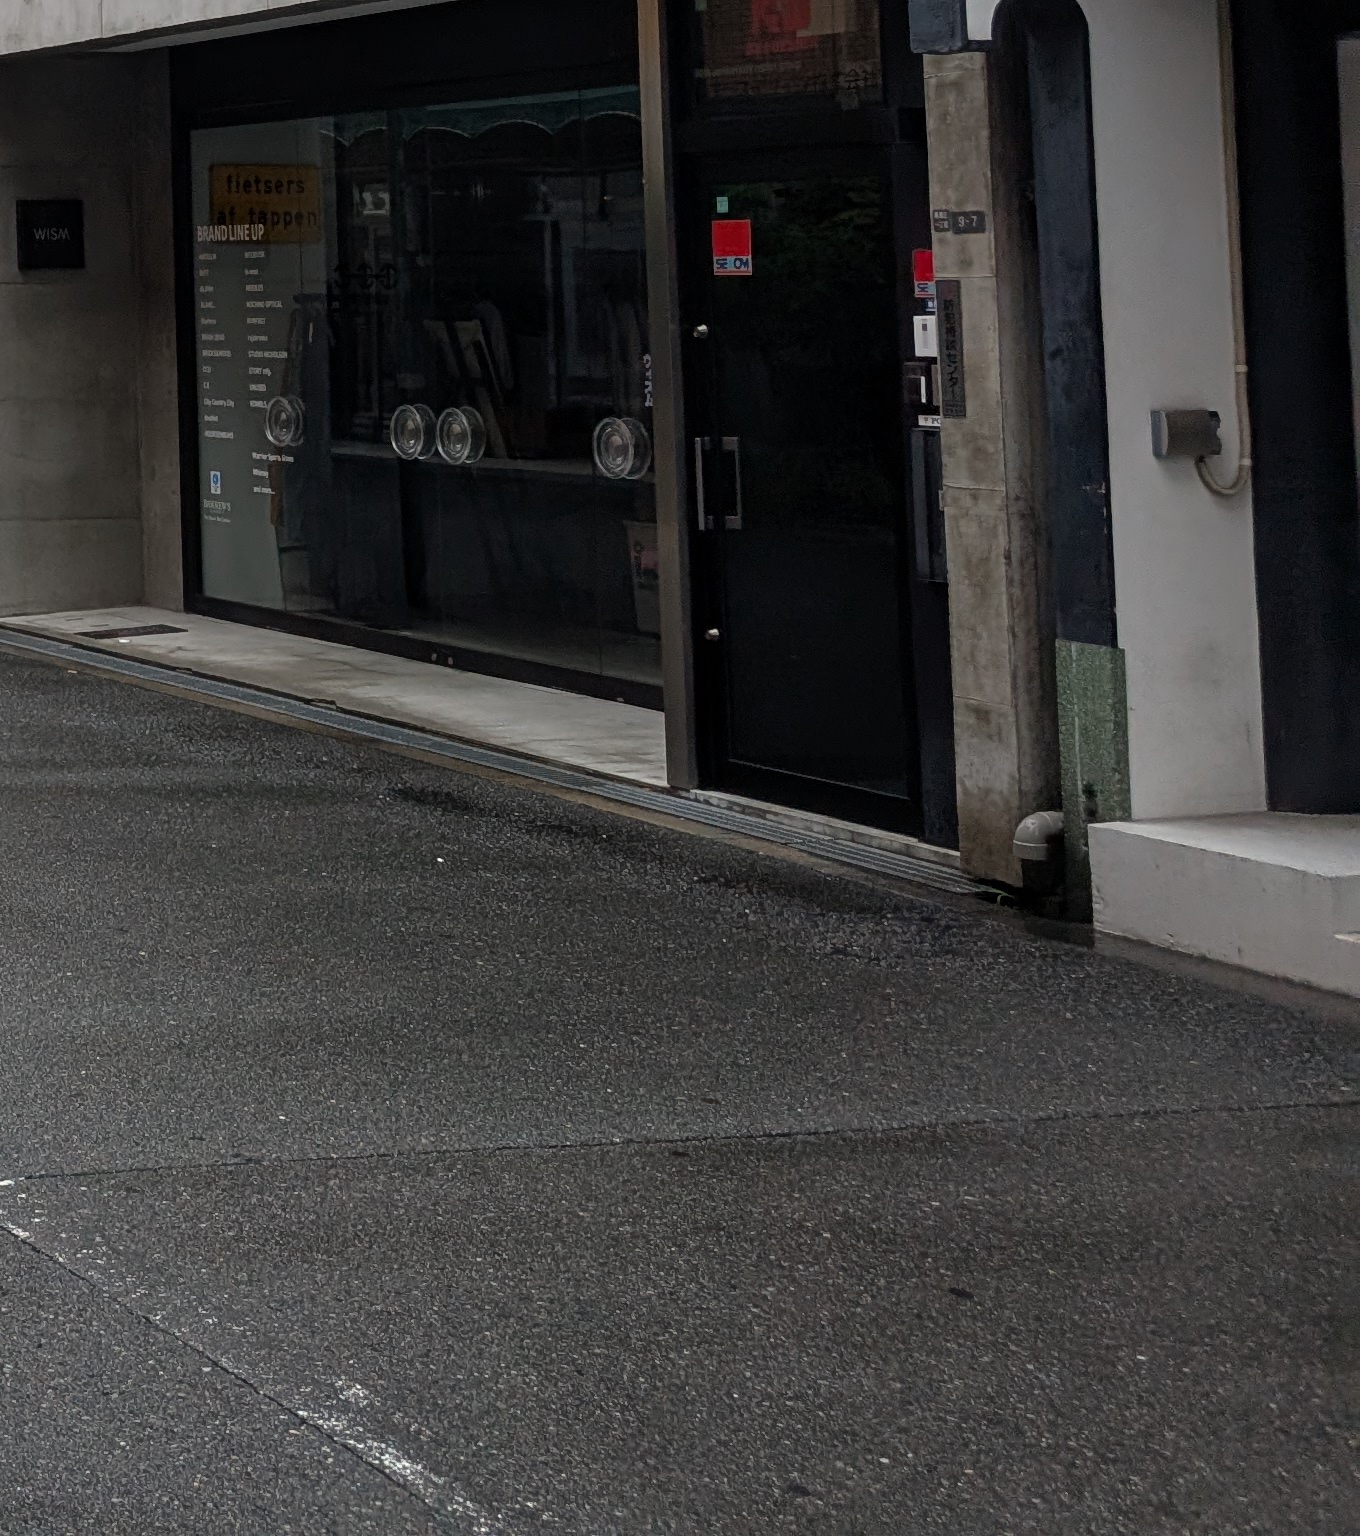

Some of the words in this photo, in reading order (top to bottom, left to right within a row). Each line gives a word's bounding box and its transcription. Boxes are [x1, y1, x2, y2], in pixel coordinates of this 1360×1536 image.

[33, 227, 71, 241] WISM
[197, 225, 228, 242] BRAND
[229, 224, 250, 241] LINE
[251, 224, 265, 241] UP
